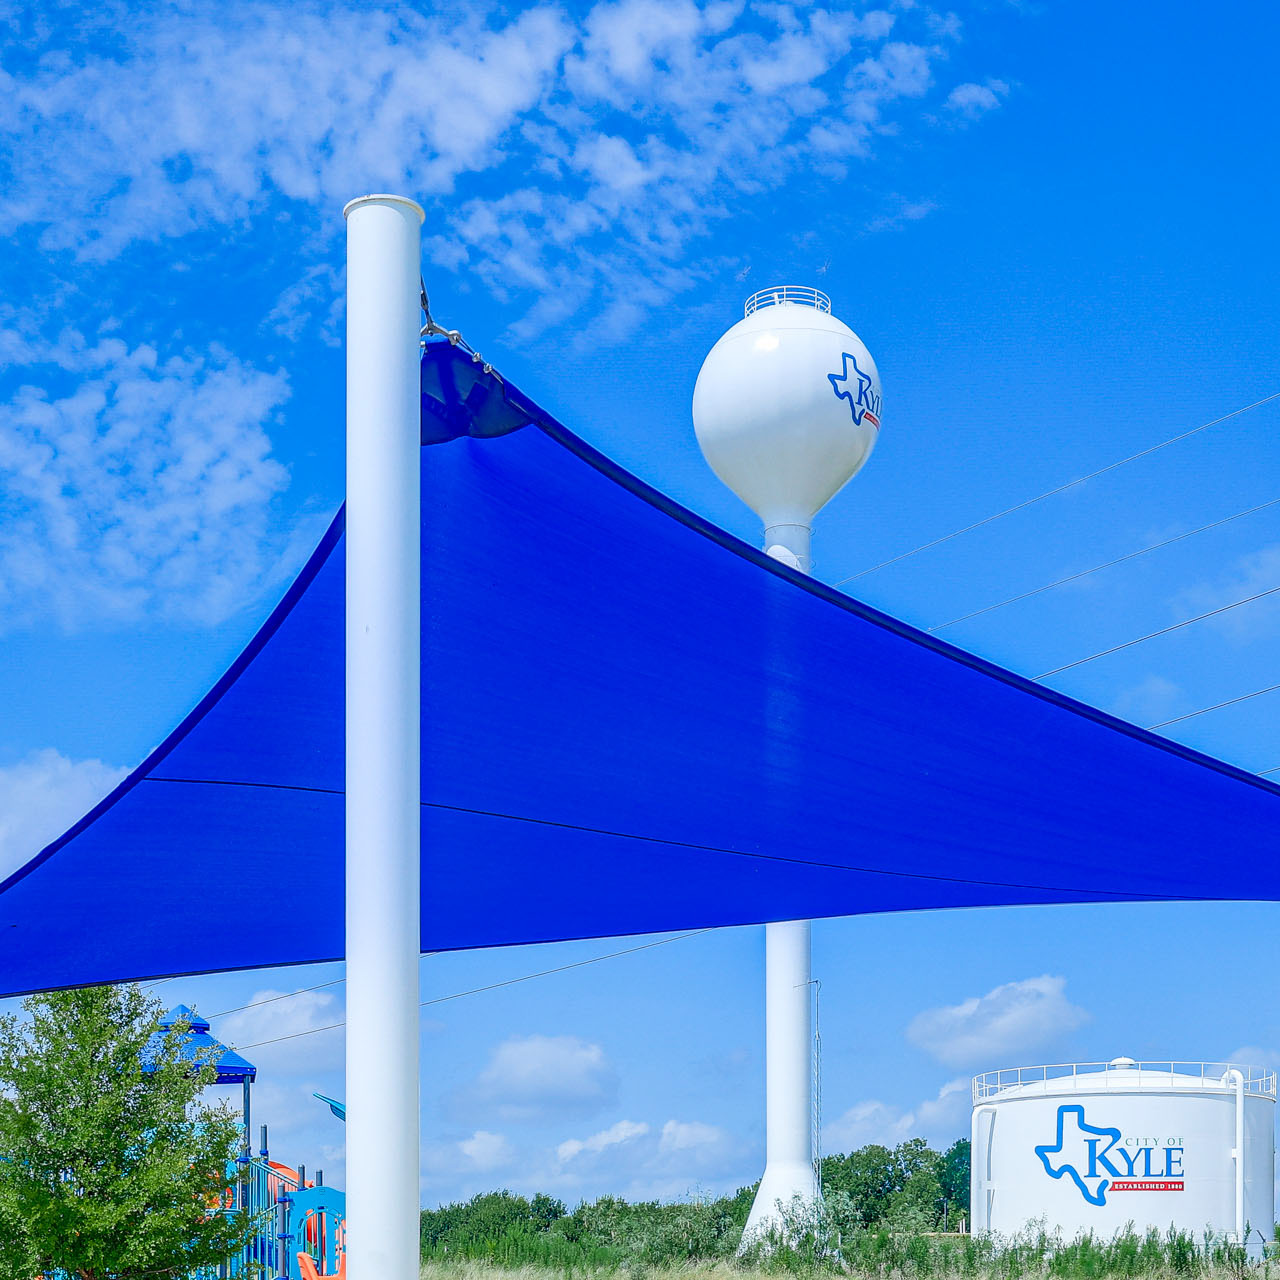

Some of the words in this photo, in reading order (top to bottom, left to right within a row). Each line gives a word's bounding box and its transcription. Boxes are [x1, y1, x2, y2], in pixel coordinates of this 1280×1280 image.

[1125, 1137, 1160, 1146] CITY
[1167, 1137, 1184, 1146] OF
[1083, 1138, 1185, 1178] KYLE
